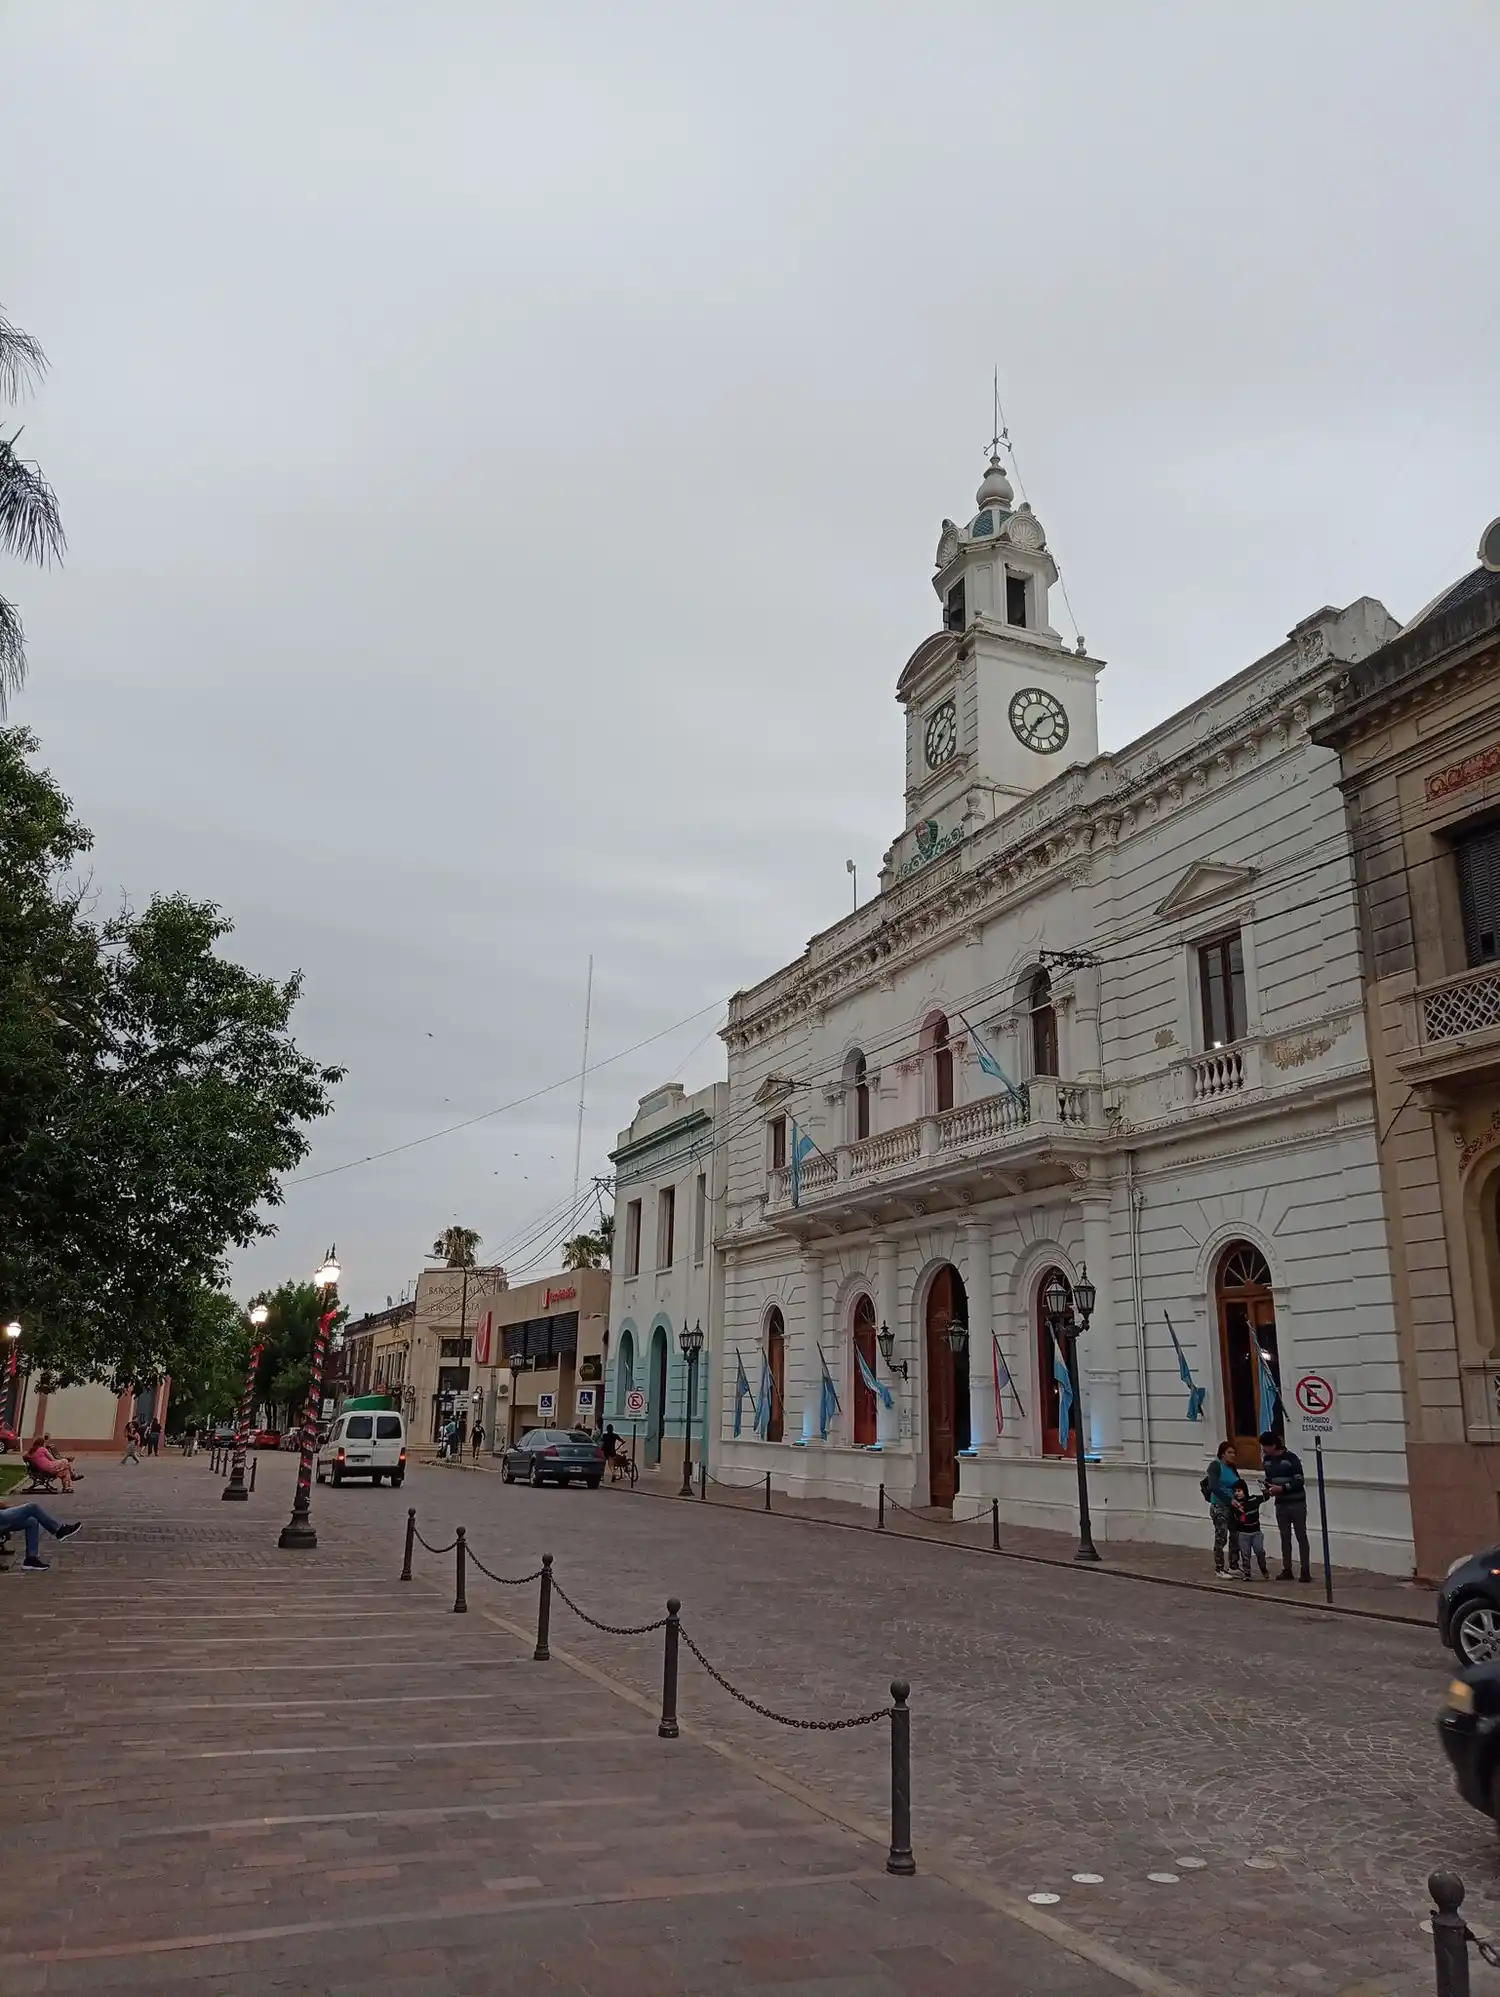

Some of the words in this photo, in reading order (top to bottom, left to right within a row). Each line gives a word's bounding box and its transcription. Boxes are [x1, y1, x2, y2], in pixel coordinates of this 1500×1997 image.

[428, 1286, 456, 1295] BANCO
[1303, 1416, 1330, 1424] PROHIBIDO
[1301, 1424, 1334, 1432] ESTACIONAR
